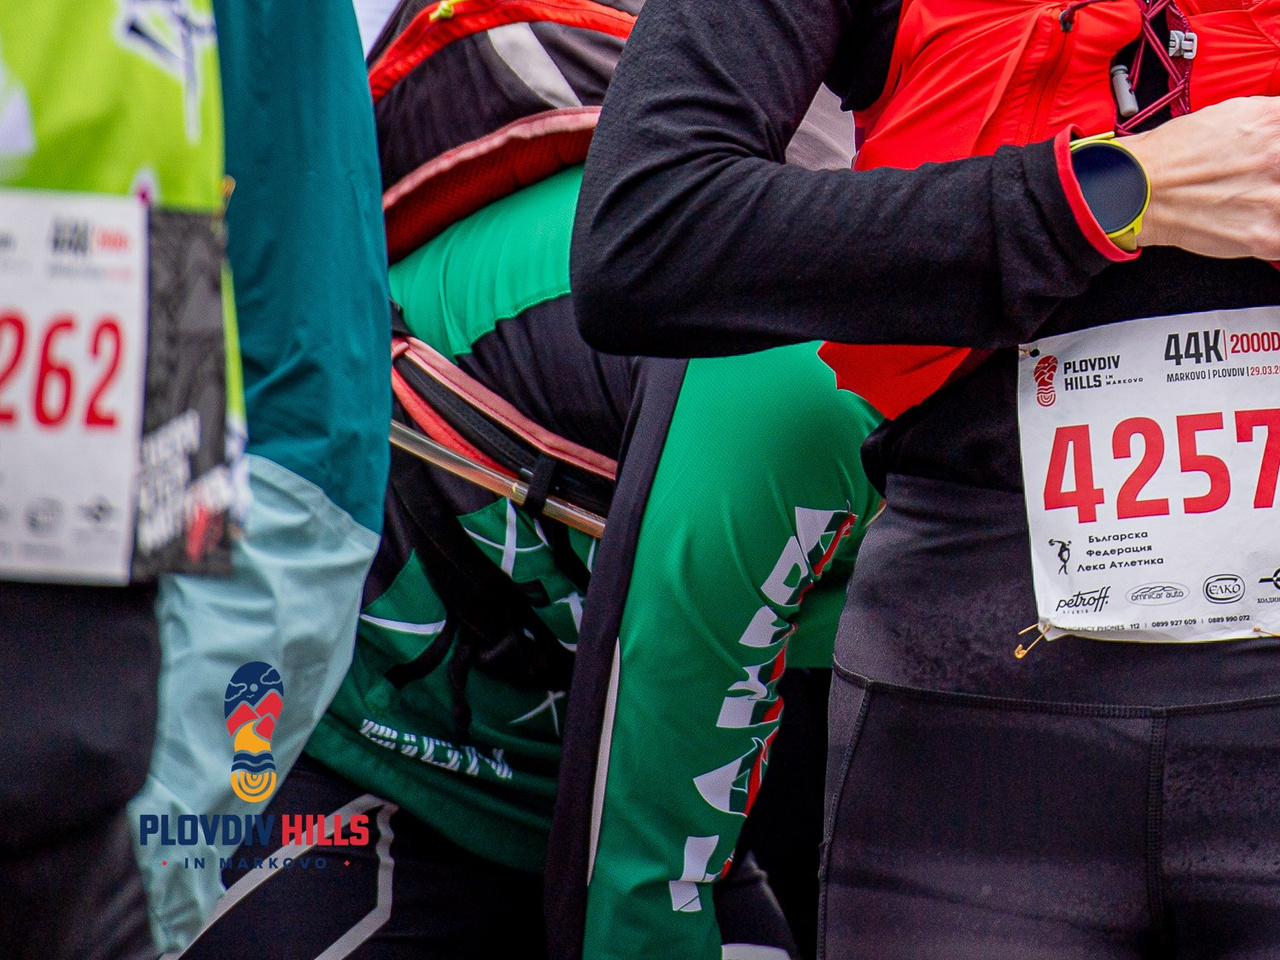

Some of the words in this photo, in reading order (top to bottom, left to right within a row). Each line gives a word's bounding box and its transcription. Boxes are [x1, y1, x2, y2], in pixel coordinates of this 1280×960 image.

[1164, 329, 1223, 366] 44K
[1063, 355, 1121, 375] PLOVDIV
[1166, 370, 1206, 382] MARKOVO
[1212, 367, 1245, 378] PLOVDIV
[1064, 374, 1103, 391] HILLS
[1088, 530, 1148, 544] Българска
[1086, 544, 1152, 558] Федерация
[1077, 563, 1106, 572] Лека
[1109, 557, 1164, 569] Атлетика
